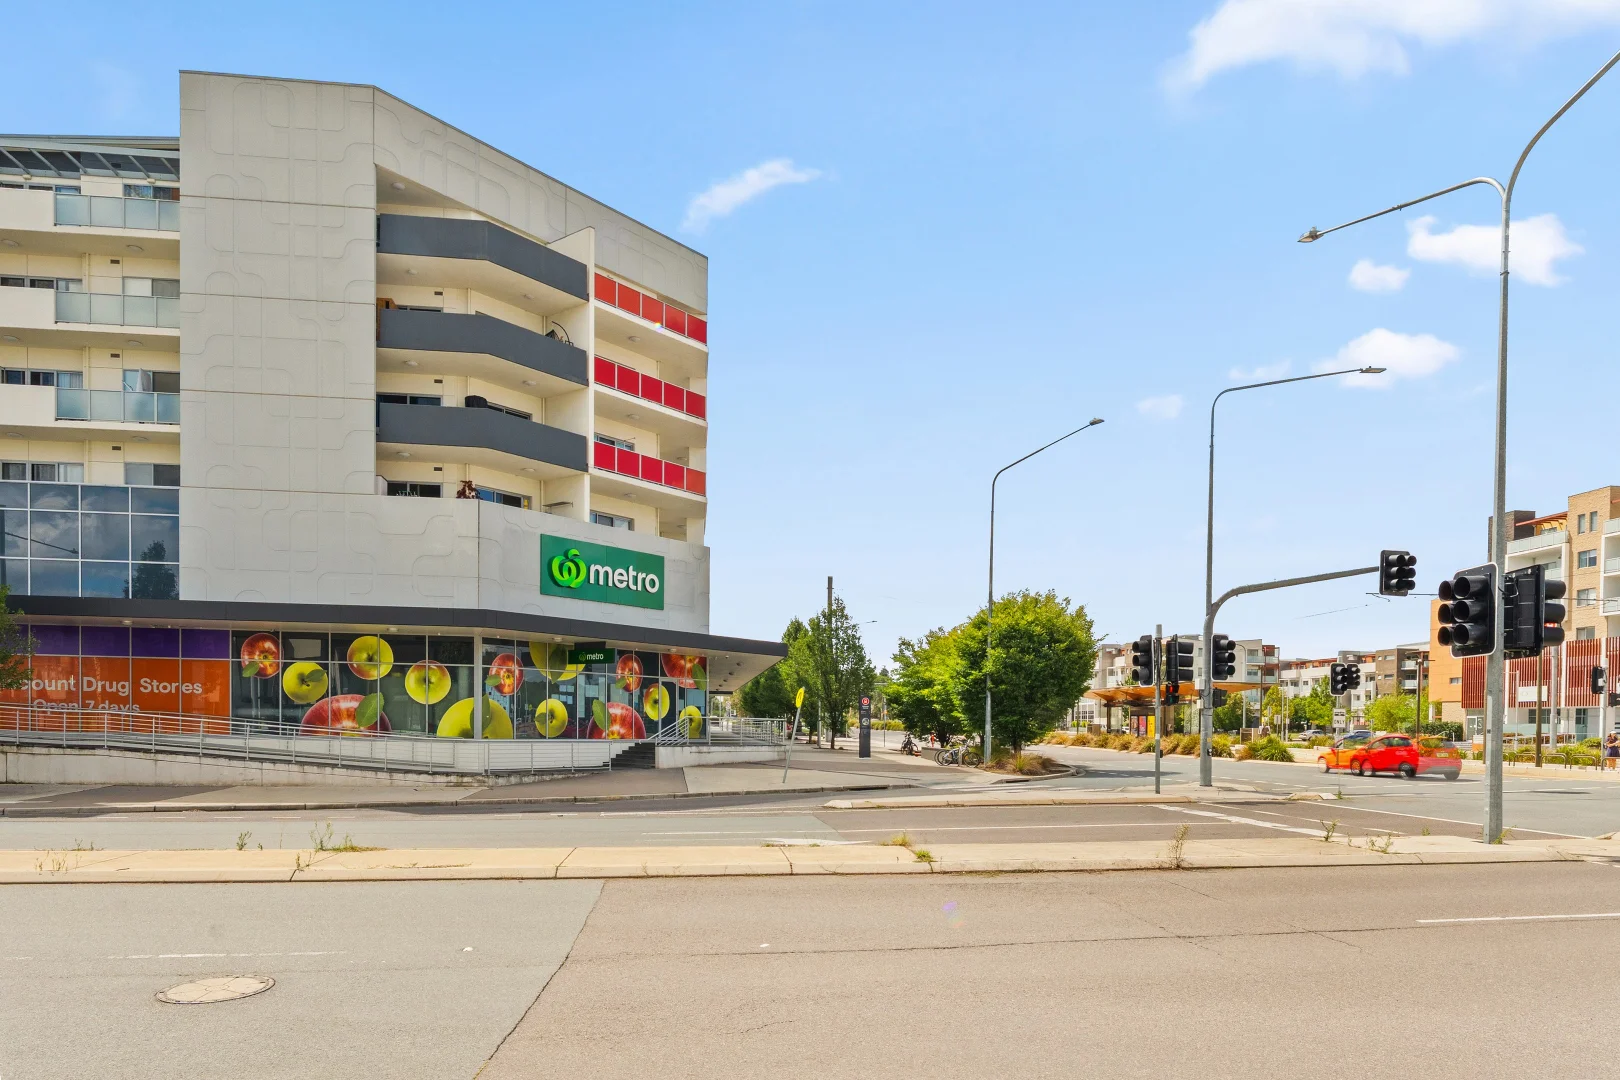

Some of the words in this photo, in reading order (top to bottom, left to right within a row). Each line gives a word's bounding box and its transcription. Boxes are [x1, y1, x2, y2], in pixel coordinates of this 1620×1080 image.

[589, 563, 660, 593] metro
[586, 652, 604, 660] metro
[11, 675, 77, 691] count
[82, 676, 130, 697] Drug
[139, 677, 203, 694] Stores
[85, 700, 96, 711] 7
